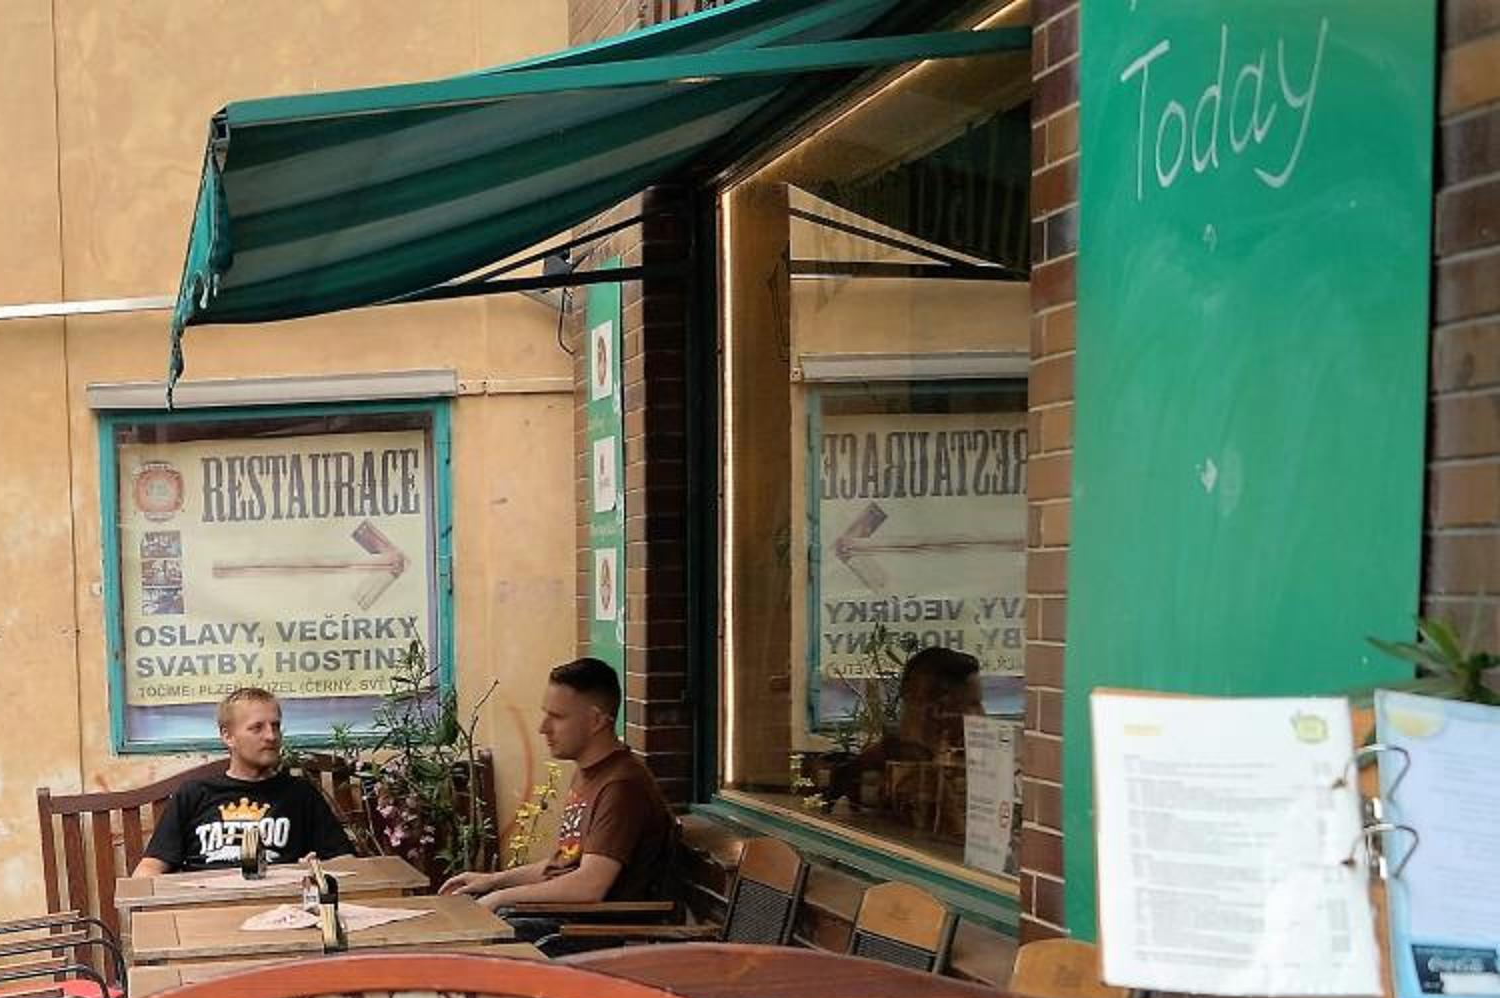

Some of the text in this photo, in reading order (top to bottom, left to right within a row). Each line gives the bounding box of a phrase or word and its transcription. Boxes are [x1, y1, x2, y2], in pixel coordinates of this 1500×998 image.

[1120, 17, 1329, 201] Today
[201, 449, 420, 523] RESTAURACE
[135, 614, 418, 648] OSLAVY, VEČÍRKY
[135, 653, 263, 678] SVATBY,
